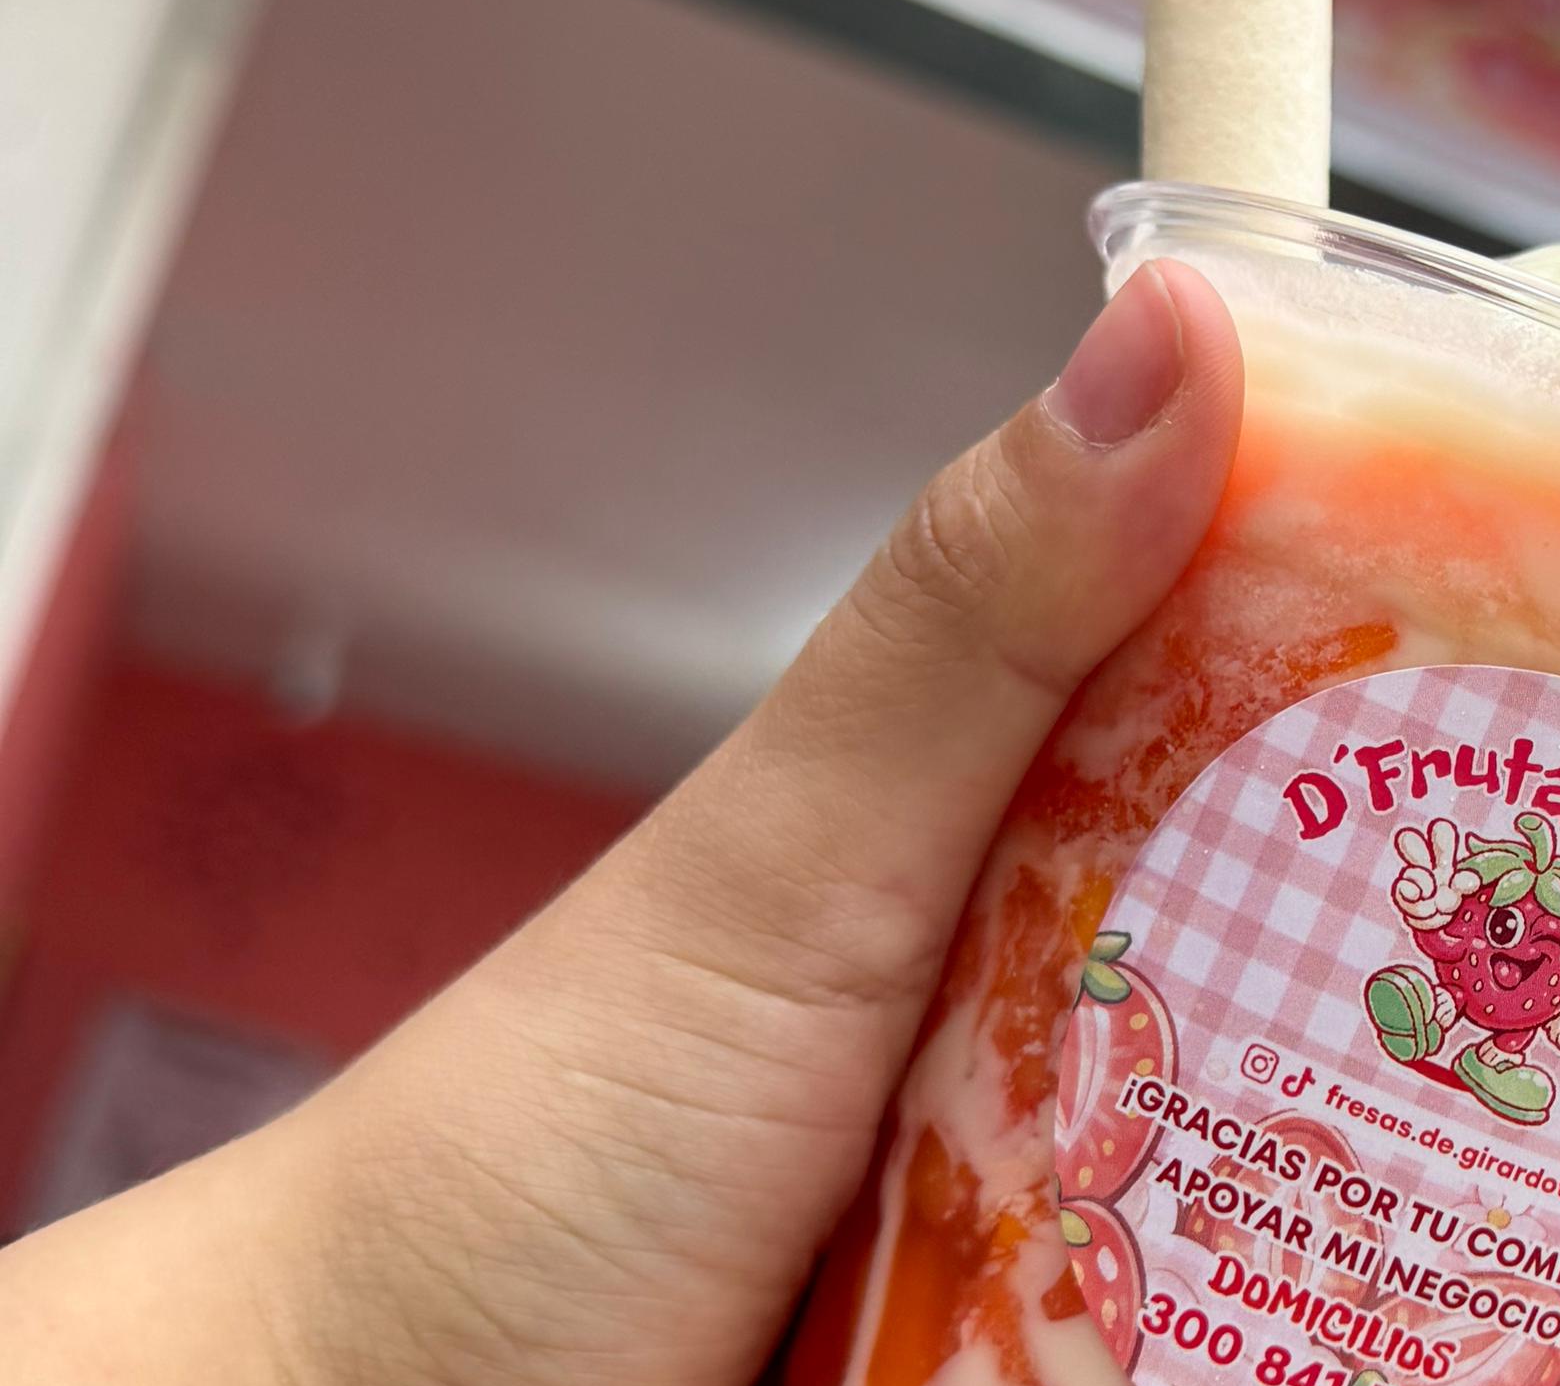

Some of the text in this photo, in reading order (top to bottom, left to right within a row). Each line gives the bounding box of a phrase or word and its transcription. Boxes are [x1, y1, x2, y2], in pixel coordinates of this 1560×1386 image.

[1121, 1079, 1306, 1181] ¡GRACIAS
[1313, 1164, 1399, 1223] POR
[1410, 1202, 1459, 1243] TU
[1156, 1158, 1313, 1252] APOYAR
[1321, 1232, 1378, 1277] MI
[1142, 1293, 1244, 1365] 300
[1208, 1256, 1456, 1379] DOMICILIOS
